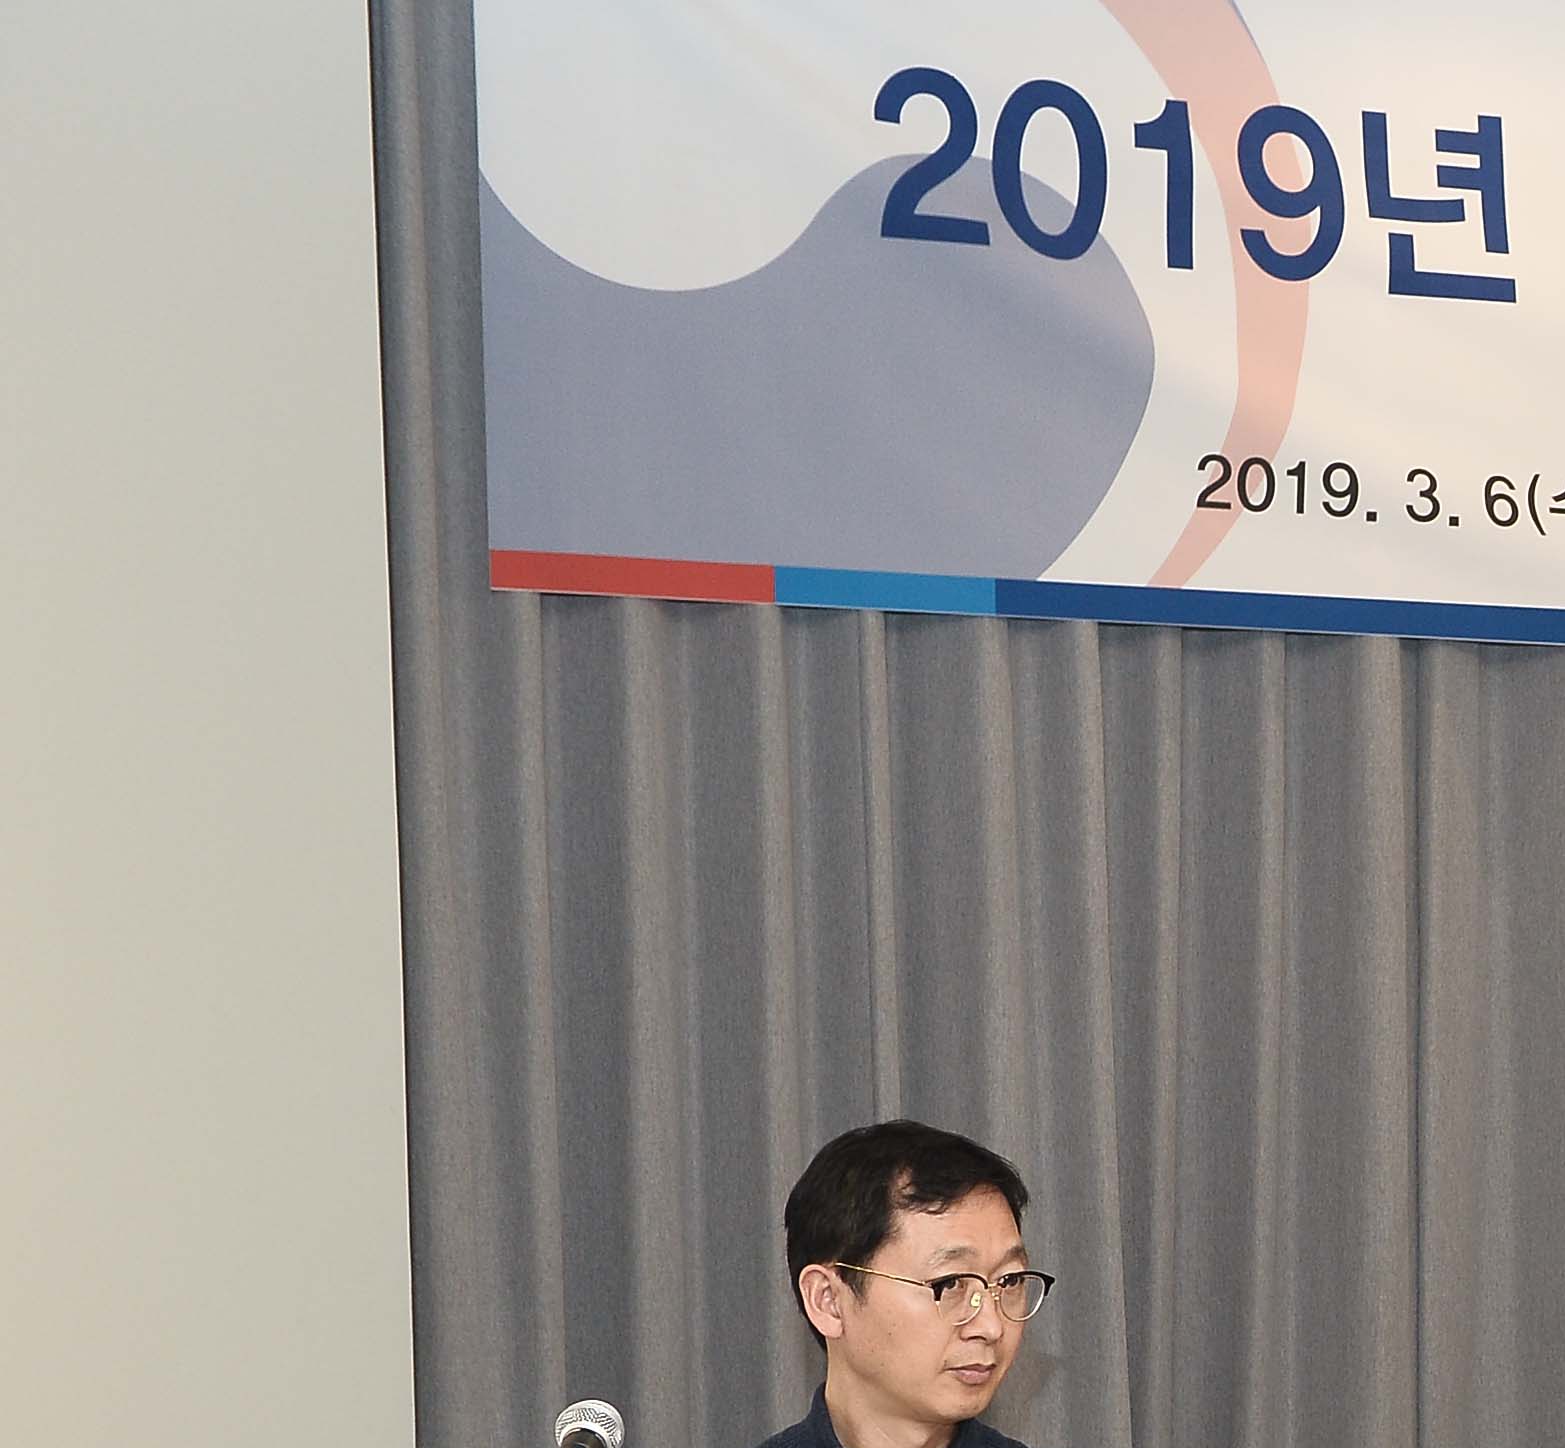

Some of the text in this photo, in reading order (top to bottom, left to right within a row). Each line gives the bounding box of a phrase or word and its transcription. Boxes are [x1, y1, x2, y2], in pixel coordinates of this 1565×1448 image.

[873, 66, 1517, 304] 2019년
[1196, 454, 1379, 522] 2019.
[1404, 468, 1460, 527] 3.
